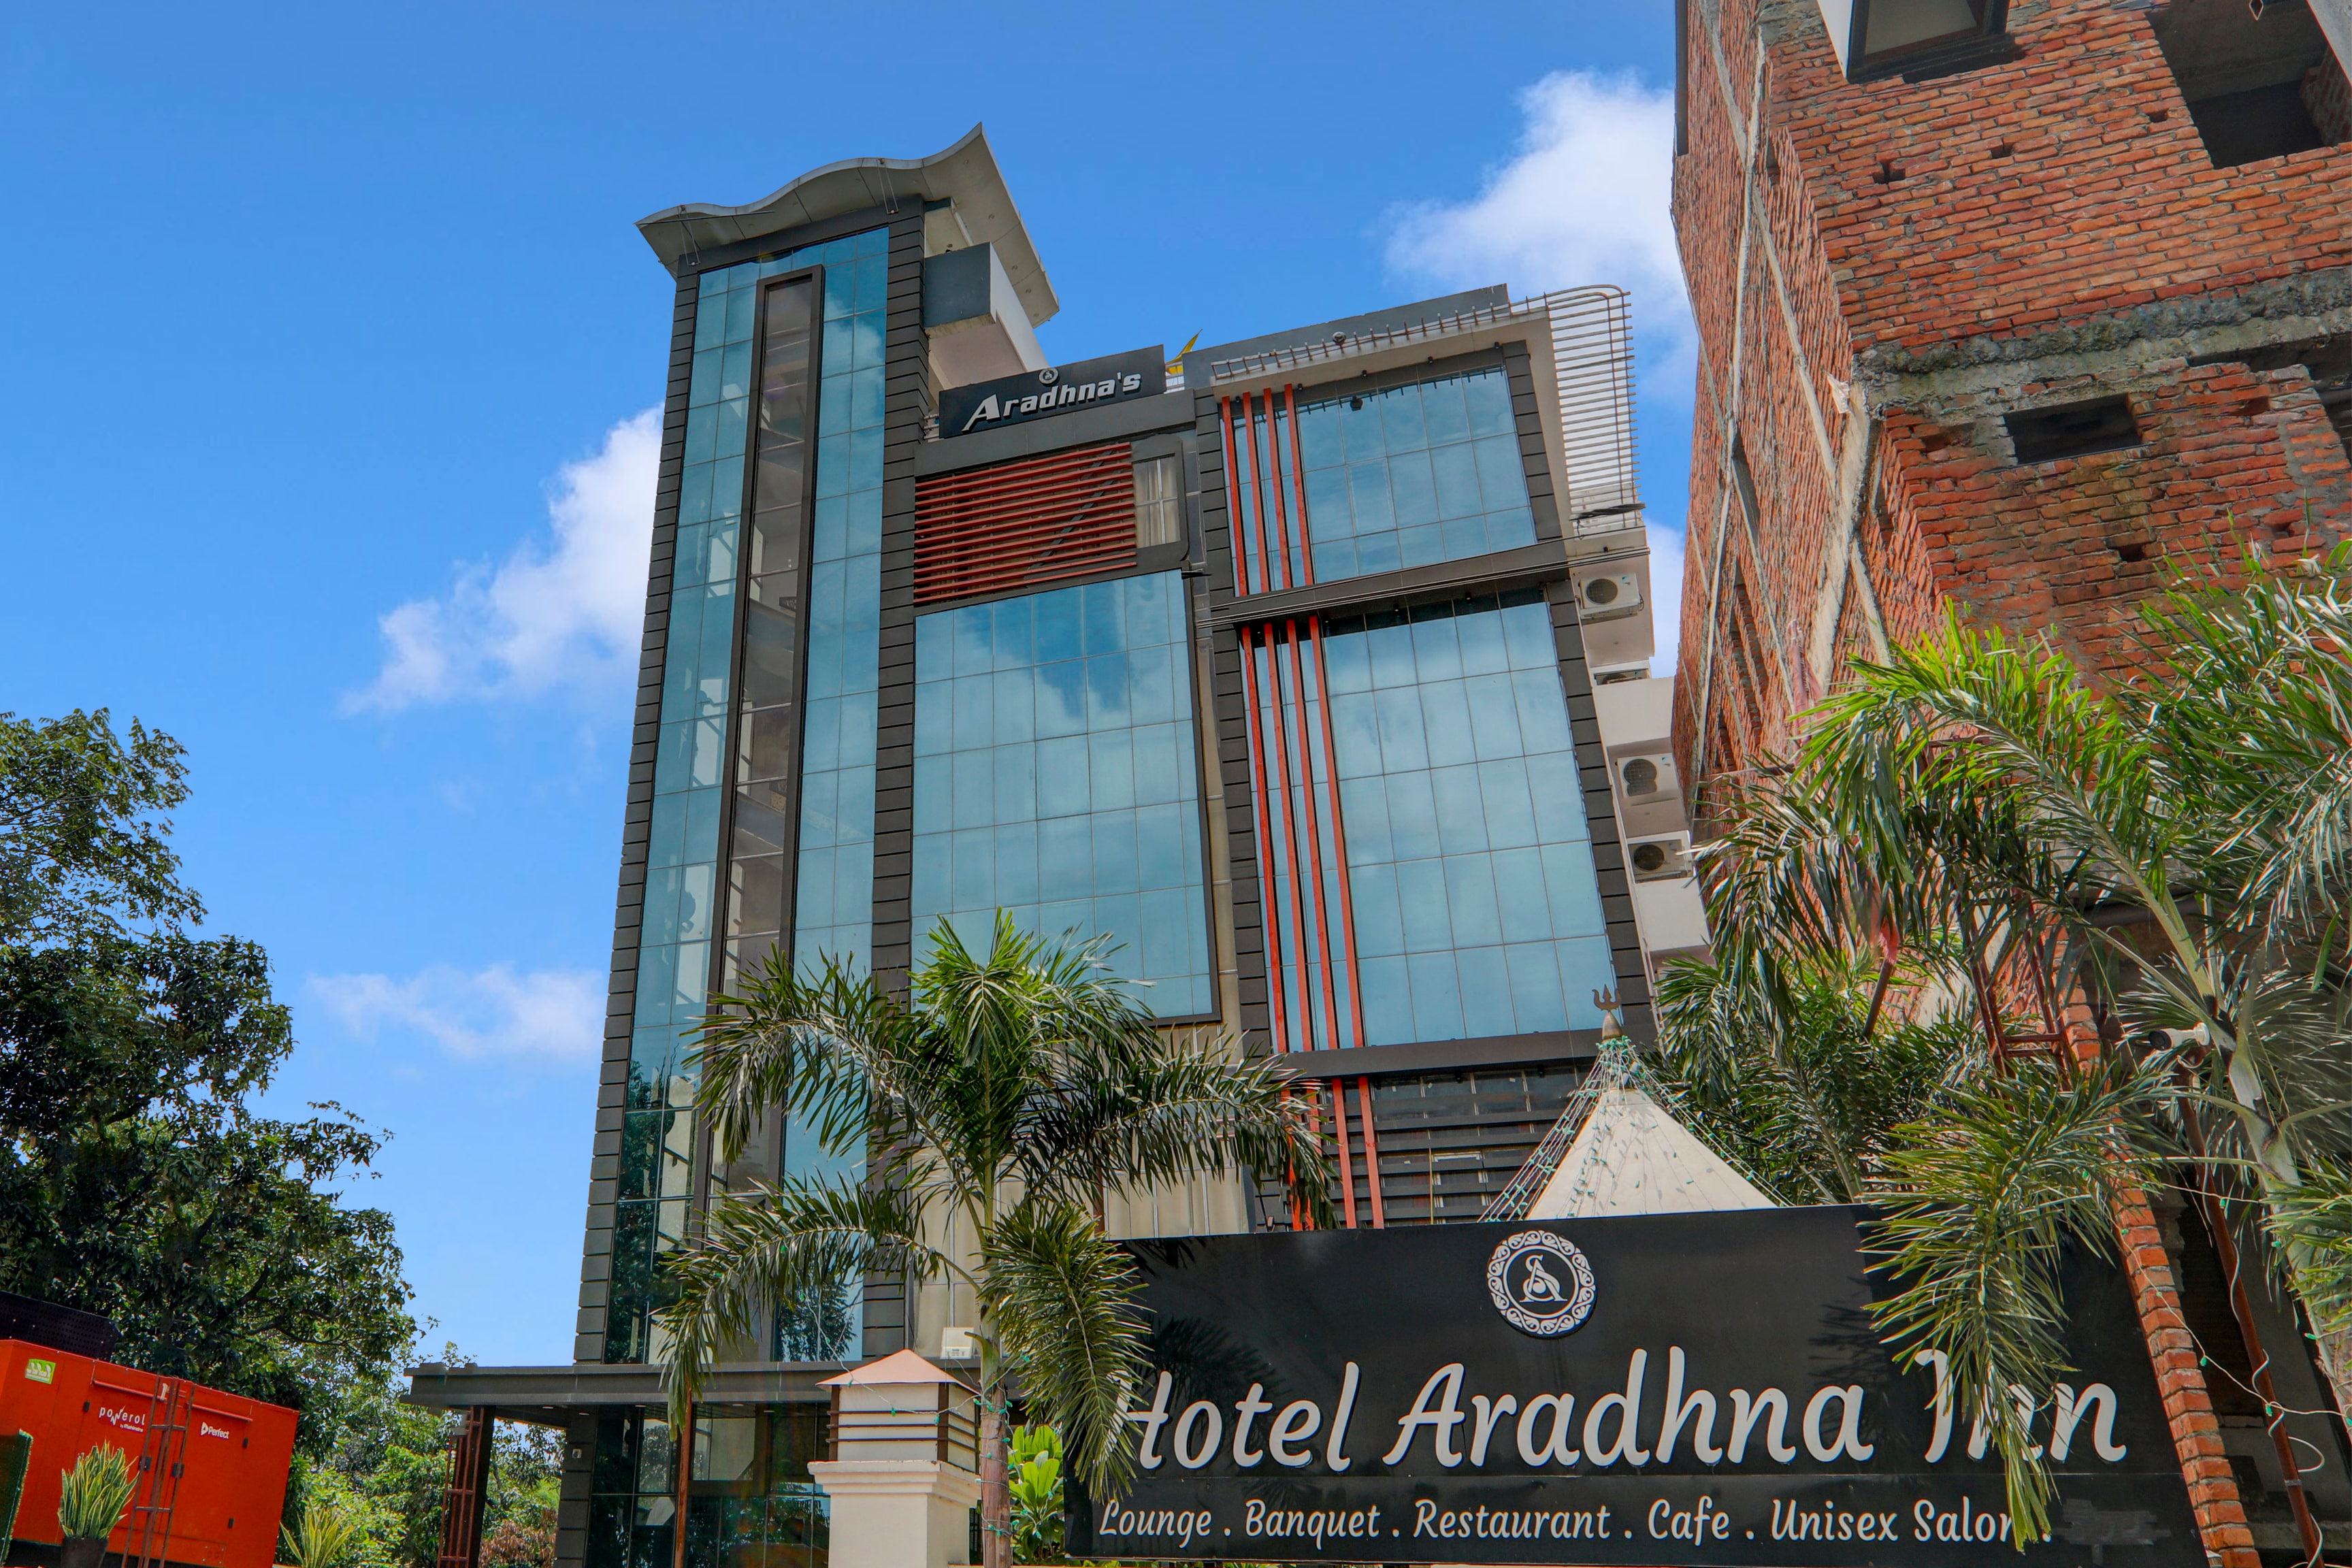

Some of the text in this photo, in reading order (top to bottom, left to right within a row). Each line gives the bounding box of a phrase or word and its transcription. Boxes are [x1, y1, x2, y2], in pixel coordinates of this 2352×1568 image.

[962, 372, 1142, 431] Aradhna's
[208, 1426, 229, 1439] Perfect
[1092, 1362, 1359, 1471] Hotel
[1382, 1345, 1875, 1468] Aradhna
[1098, 1499, 1212, 1548] Lounge
[1245, 1499, 1381, 1550] Banquet
[1413, 1499, 1611, 1539] Restaurant
[1648, 1495, 1731, 1547] Cafe
[1771, 1499, 1899, 1541] Unisex
